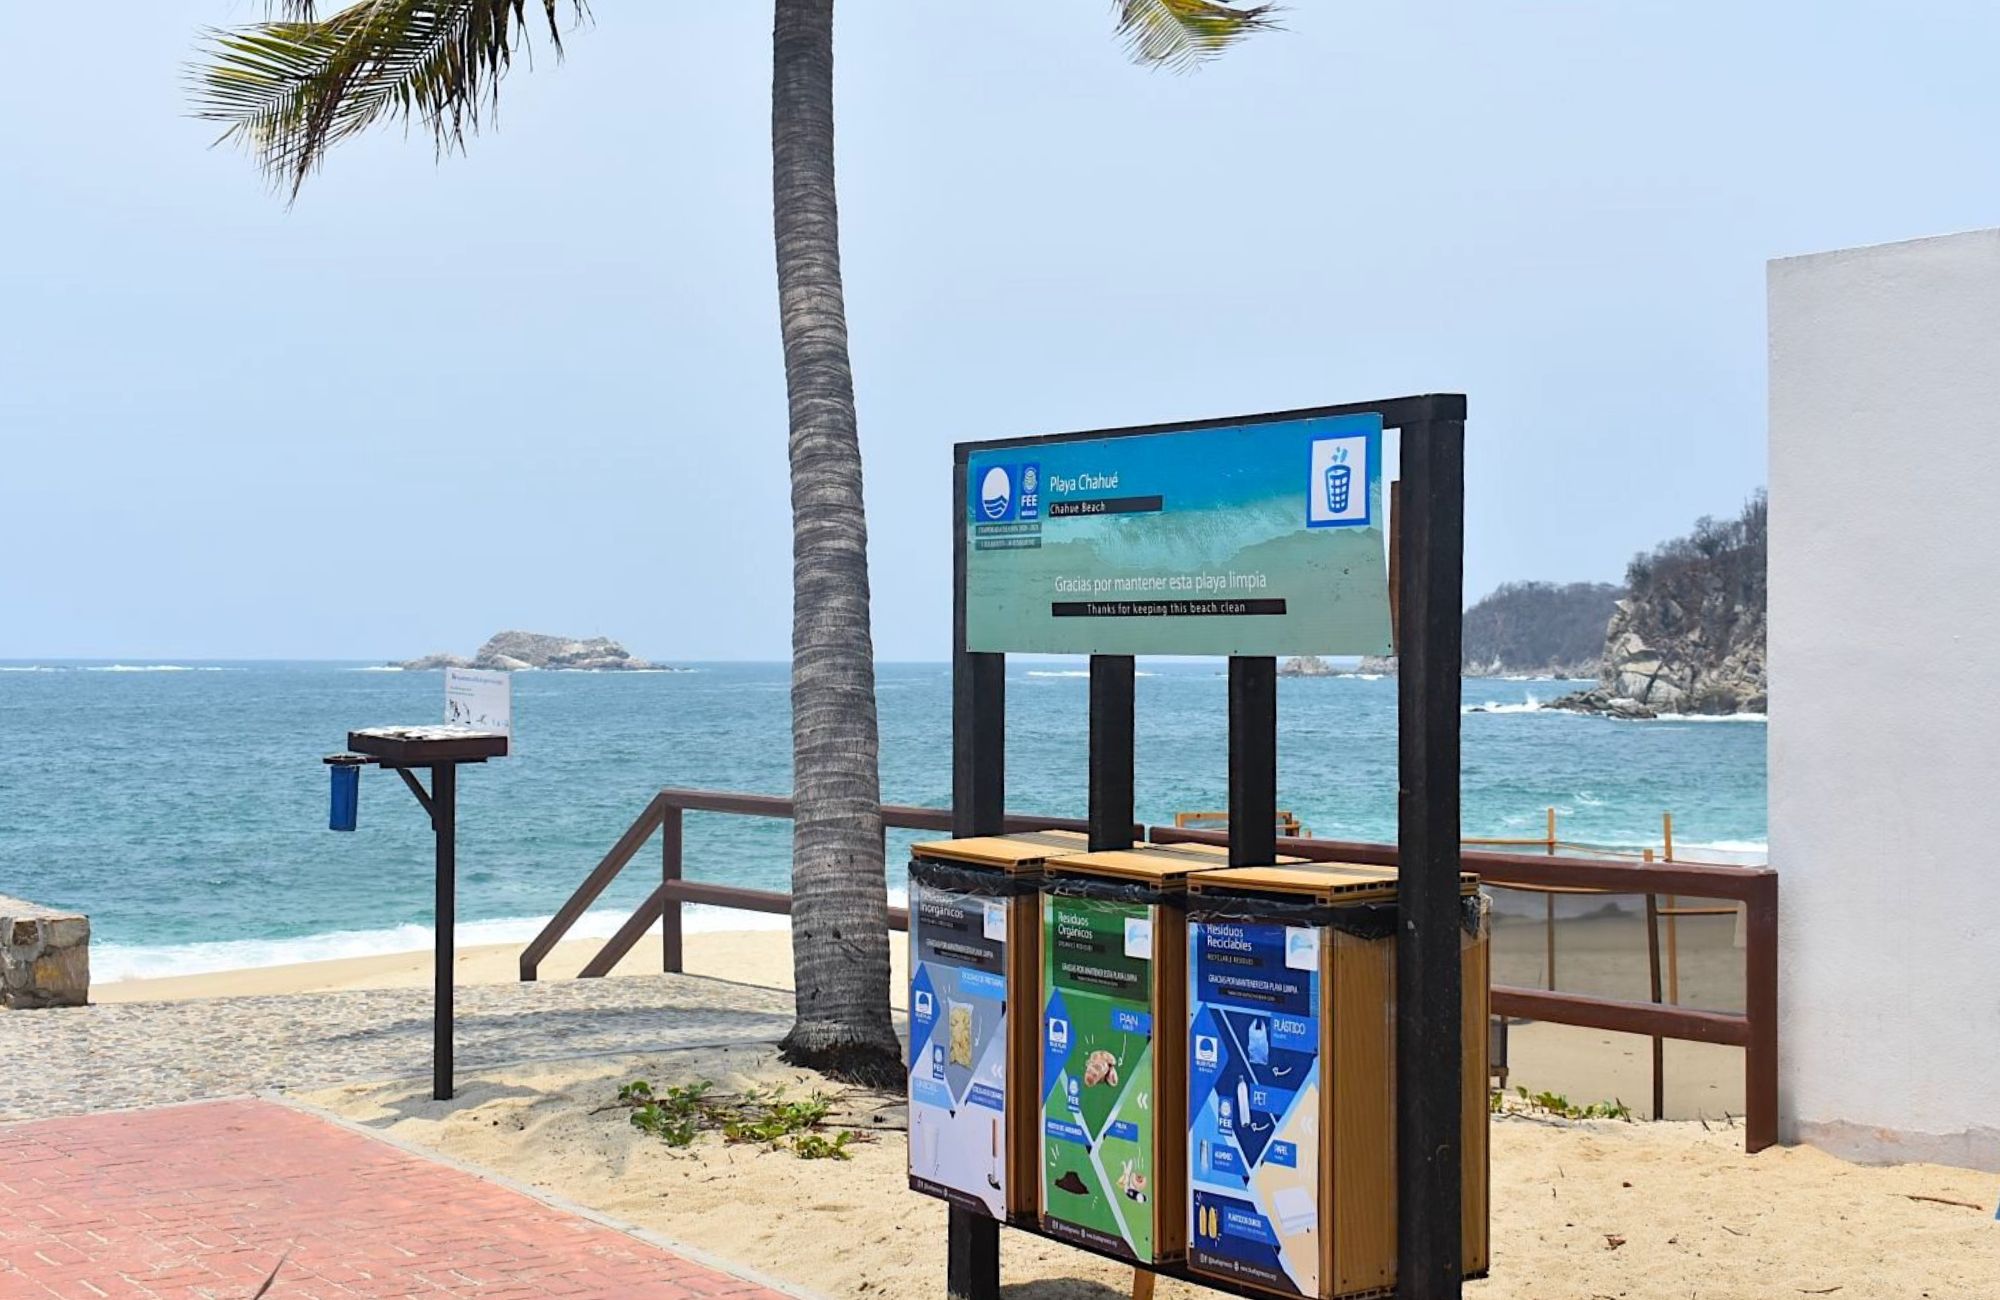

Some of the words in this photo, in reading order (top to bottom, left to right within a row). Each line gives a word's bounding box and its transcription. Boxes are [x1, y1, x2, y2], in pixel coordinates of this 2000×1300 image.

[1050, 475, 1076, 496] Playa
[1078, 471, 1118, 491] Chahué
[1021, 494, 1038, 507] FEE
[1050, 502, 1079, 515] Chahue
[1082, 501, 1105, 512] Beach
[1055, 576, 1091, 592] Gracias
[1094, 579, 1112, 596] por
[1114, 576, 1167, 591] mantener
[1169, 575, 1193, 589] esta
[1195, 571, 1226, 593] playa
[1229, 570, 1267, 592] limpia
[1087, 604, 1116, 614] Thanks
[1118, 603, 1131, 614] for
[1133, 603, 1168, 616] keeping
[1170, 602, 1187, 613] this
[1190, 602, 1217, 613] beach
[1221, 602, 1245, 612] clean
[1058, 911, 1089, 926] Residuos
[1058, 924, 1093, 939] Orgánicos
[1207, 923, 1244, 938] Residuos
[1207, 935, 1252, 951] Reciclables
[1119, 1012, 1139, 1025] PAN
[1253, 1091, 1267, 1106] PET
[1219, 1118, 1232, 1127] FEE
